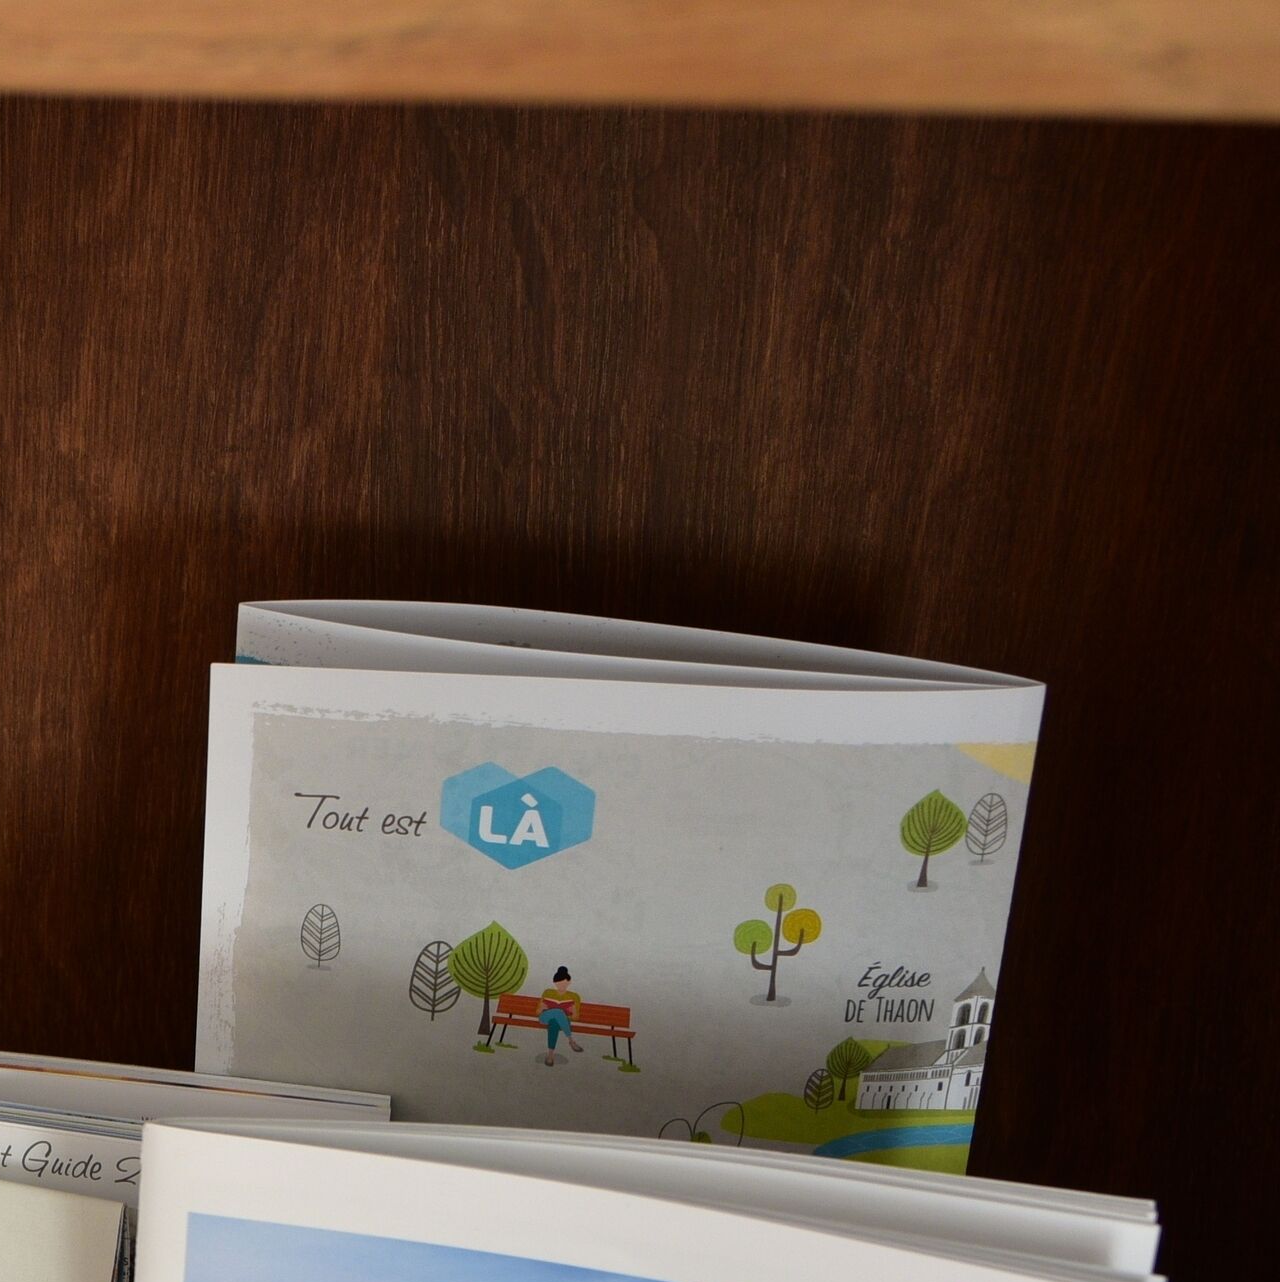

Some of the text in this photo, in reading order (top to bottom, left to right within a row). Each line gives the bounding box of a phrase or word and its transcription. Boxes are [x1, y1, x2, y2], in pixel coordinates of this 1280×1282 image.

[294, 792, 550, 848] Tout est LÀ
[857, 961, 931, 1000] Église
[844, 999, 866, 1023] DE
[22, 1140, 102, 1181] Guide
